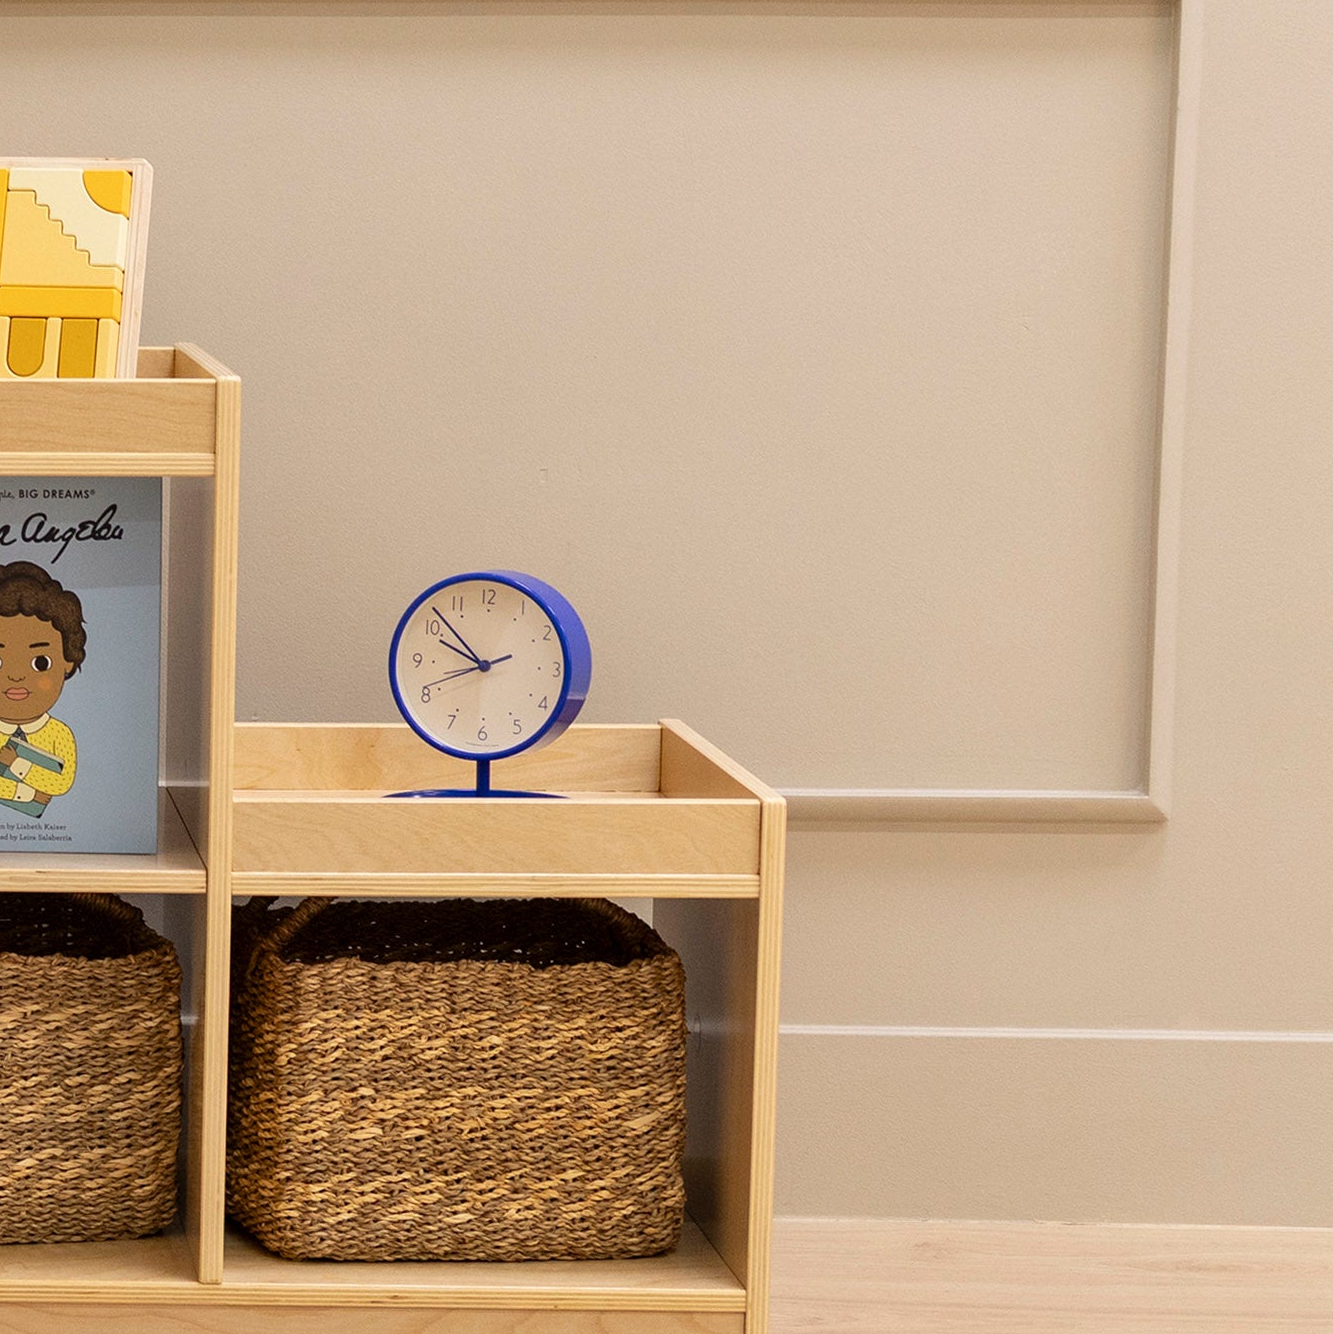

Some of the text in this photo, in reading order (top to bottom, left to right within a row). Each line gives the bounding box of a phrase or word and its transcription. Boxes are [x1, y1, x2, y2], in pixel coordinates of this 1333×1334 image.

[18, 489, 39, 499] BIG
[21, 503, 124, 564] Angelou
[452, 595, 464, 612] 11
[481, 589, 497, 605] 12
[425, 619, 440, 636] 10
[542, 624, 552, 641] 2
[412, 652, 423, 668] 9
[552, 661, 561, 678] 3
[420, 686, 431, 704] 8
[537, 695, 548, 711] 4
[447, 714, 456, 730] 7
[512, 719, 522, 735] 5
[477, 725, 488, 741] 6
[6, 822, 15, 831] by
[9, 833, 18, 842] by
